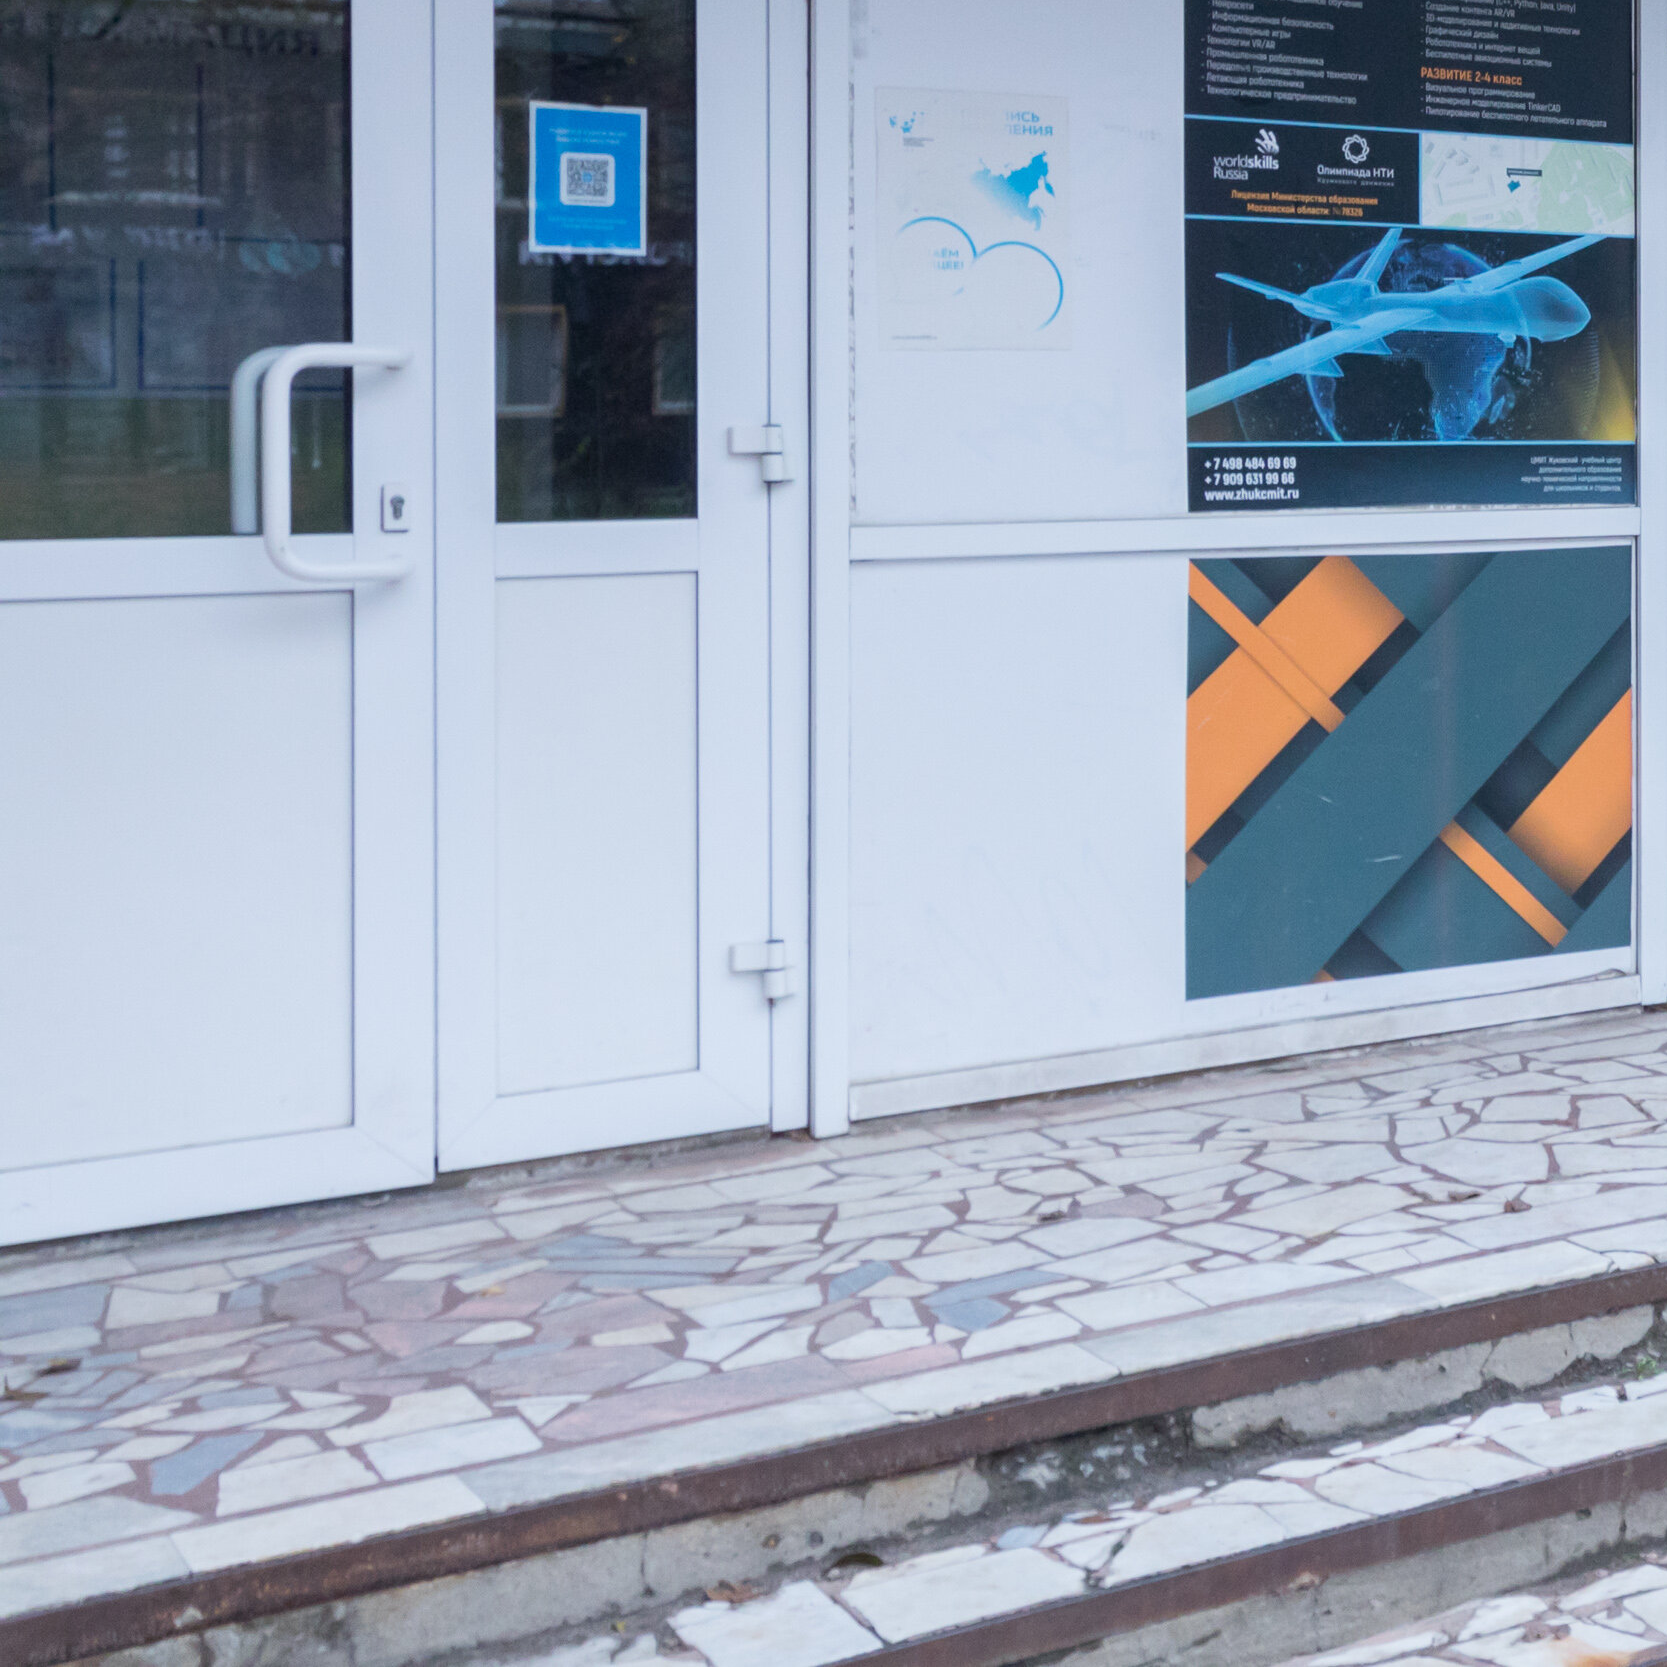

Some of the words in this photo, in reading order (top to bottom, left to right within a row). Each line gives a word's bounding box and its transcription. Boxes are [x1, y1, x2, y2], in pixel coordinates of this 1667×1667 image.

[1493, 7, 1515, 18] AR/VR
[1206, 34, 1251, 47] Технологии
[1251, 38, 1276, 49] VR/AR
[1271, 29, 1291, 40] игры
[1420, 66, 1472, 82] РАЗВИТИЕ
[1474, 70, 1491, 83] 2-4
[1492, 74, 1522, 86] класс
[1212, 154, 1280, 170] worldskills
[1212, 165, 1249, 180] Russia
[1316, 163, 1371, 179] Олимпиада
[1372, 167, 1394, 179] НТИ
[1221, 456, 1243, 470] 498
[1244, 456, 1266, 470] 484
[1266, 456, 1281, 470] 69
[1282, 455, 1297, 470] 69
[1222, 472, 1244, 486] 909
[1244, 472, 1263, 485] 631
[1264, 471, 1280, 485] 99
[1280, 471, 1295, 485] 66
[1203, 487, 1300, 501] www.zhukcmit.ru
